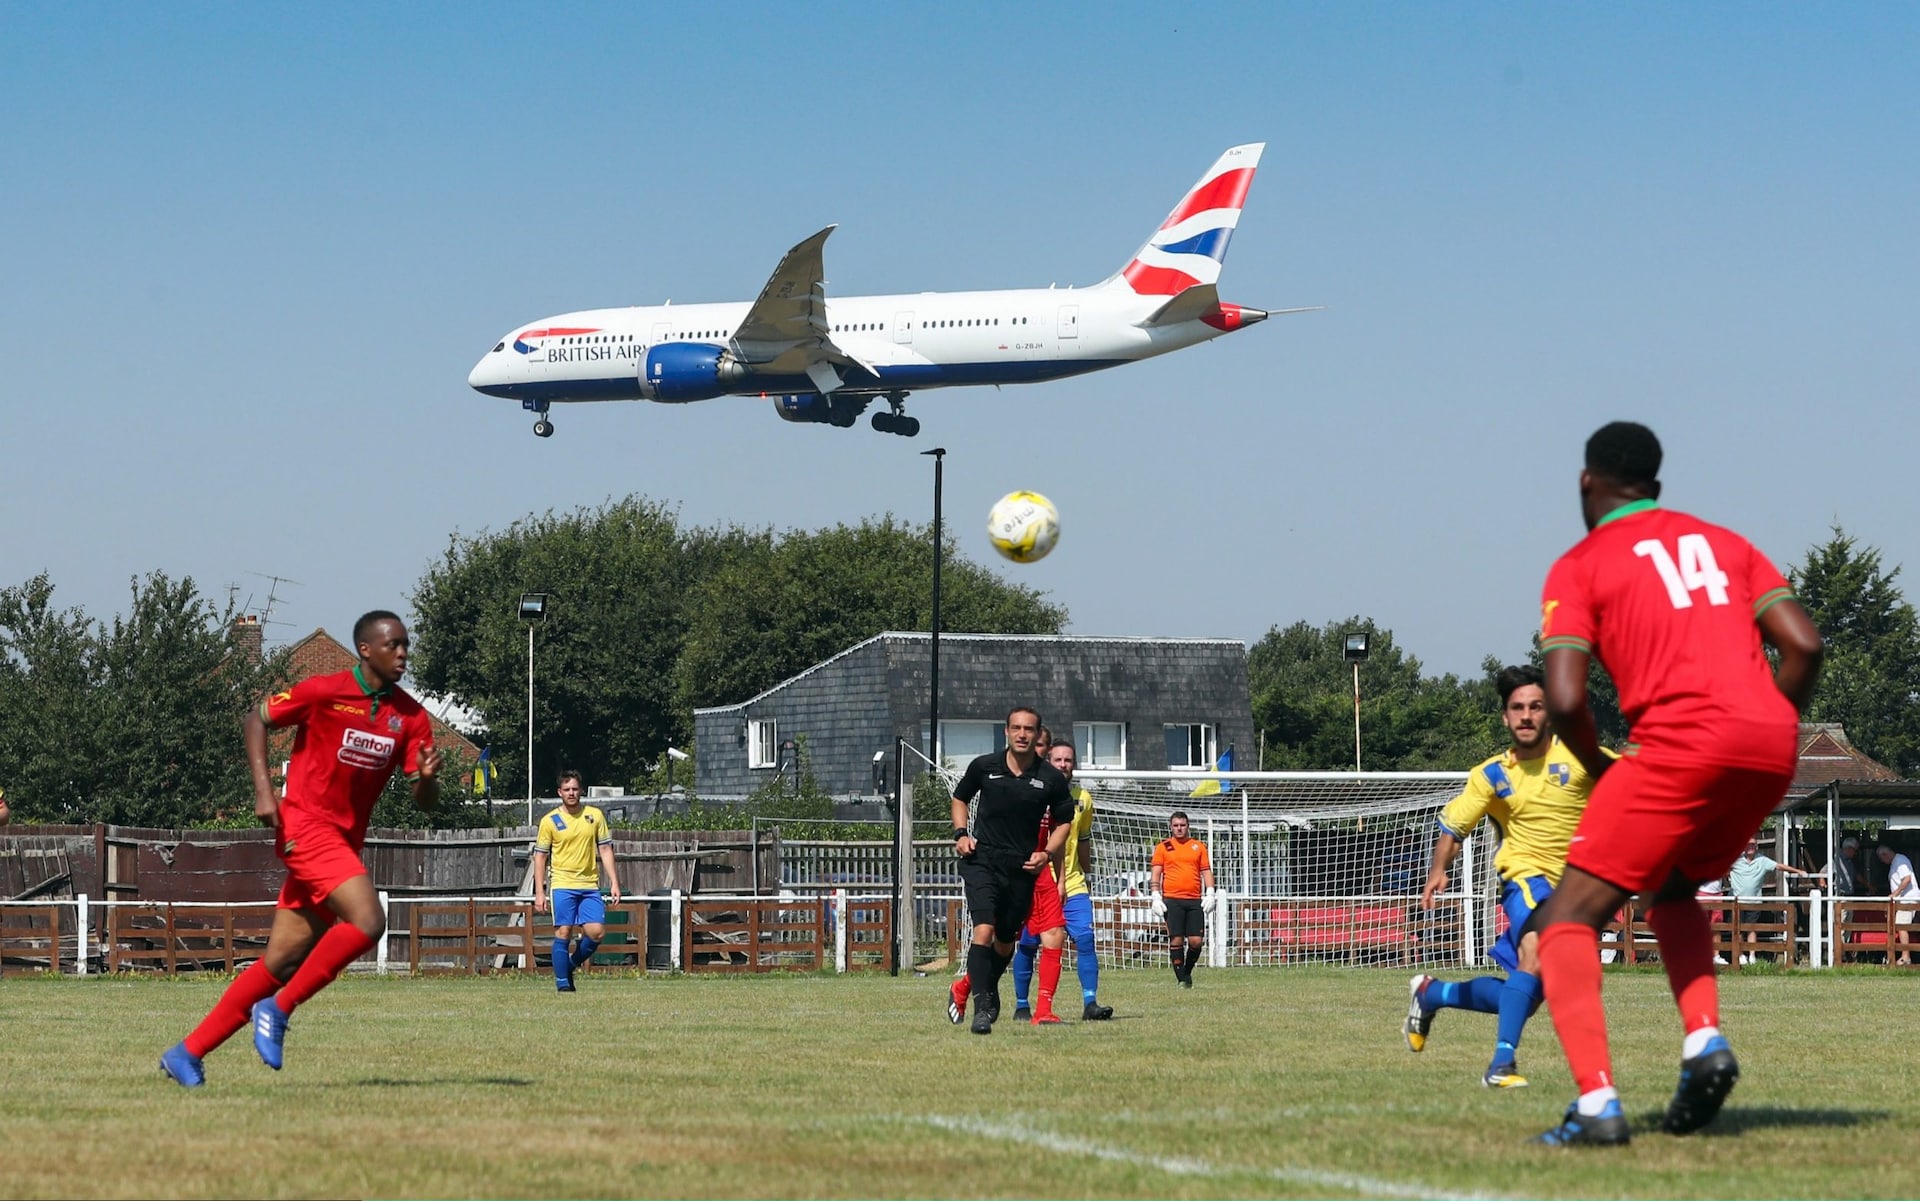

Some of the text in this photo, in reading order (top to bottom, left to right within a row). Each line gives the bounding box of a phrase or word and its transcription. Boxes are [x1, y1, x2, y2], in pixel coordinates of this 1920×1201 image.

[548, 346, 611, 363] BRITISH
[1632, 533, 1730, 610] 14
[346, 731, 392, 754] Fenton
